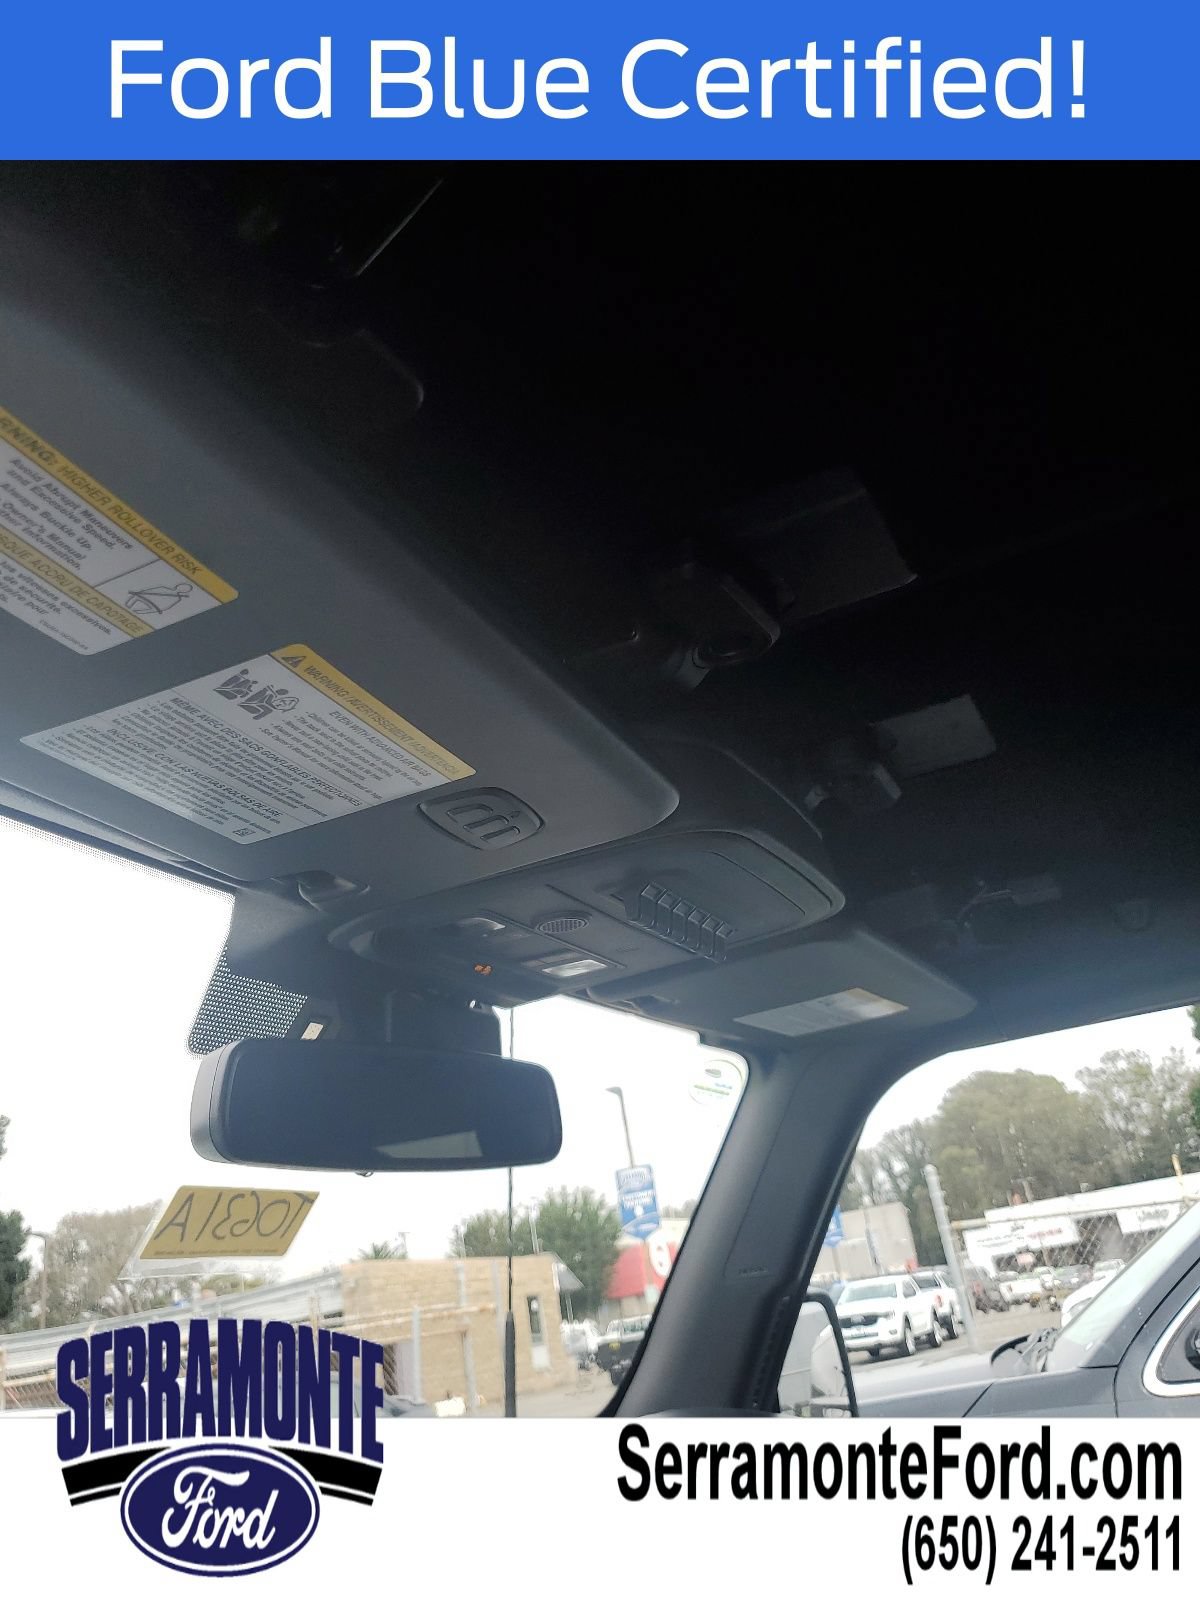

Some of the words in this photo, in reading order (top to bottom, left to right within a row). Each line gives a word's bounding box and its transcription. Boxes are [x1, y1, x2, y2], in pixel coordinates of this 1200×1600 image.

[30, 485, 82, 524] Excessive
[81, 523, 116, 549] Speed.
[40, 511, 76, 538] Buckle
[57, 463, 111, 507] HIGHER
[112, 503, 176, 555] ROLLOVER
[171, 552, 202, 575] RISK
[47, 532, 87, 560] Manual
[31, 558, 73, 587] ACCRU
[69, 585, 91, 598] DE
[86, 596, 143, 632] CAPOTAGE
[300, 666, 352, 697] WARNING
[194, 713, 227, 729] AVEC
[218, 726, 245, 739] DES
[236, 736, 267, 751] SACS
[153, 752, 179, 764] CON
[172, 762, 197, 773] LAS
